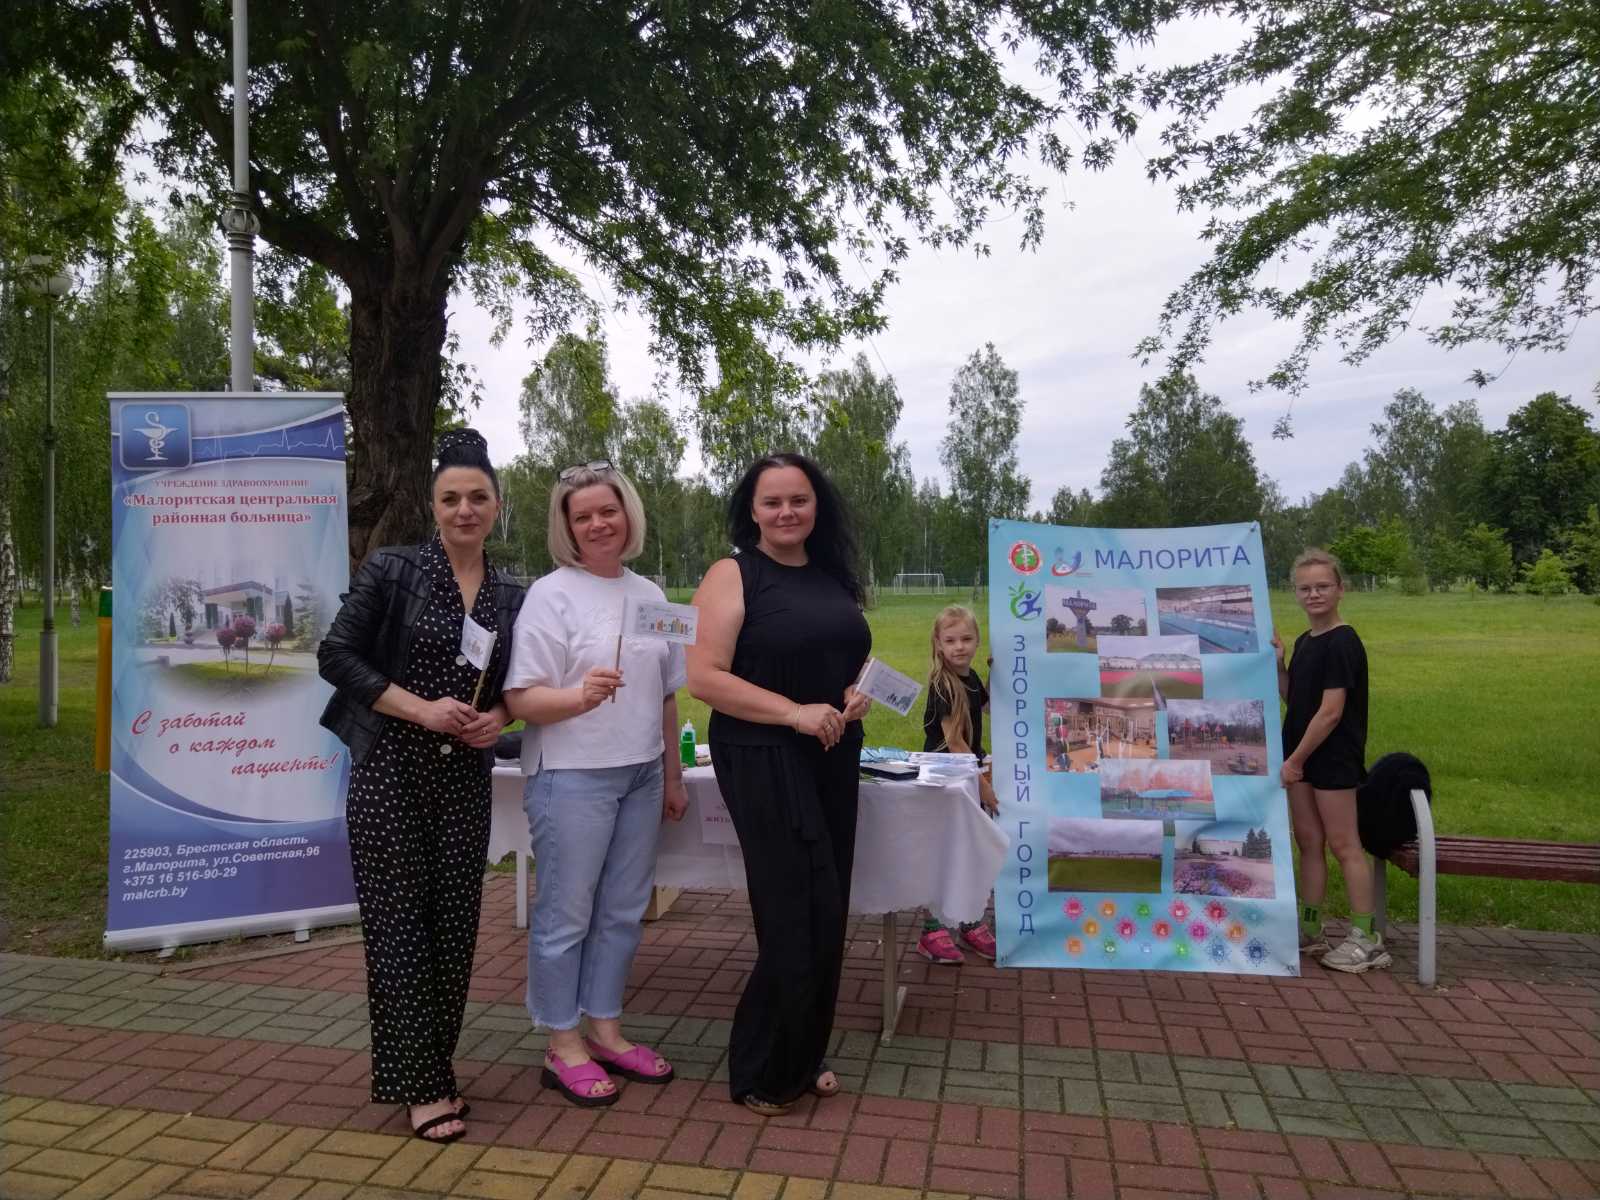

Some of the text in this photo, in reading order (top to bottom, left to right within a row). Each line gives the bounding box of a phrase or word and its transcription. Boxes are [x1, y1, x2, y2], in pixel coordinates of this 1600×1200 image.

[153, 479, 217, 488] УЧРЕЖДЕНИЕ
[123, 493, 338, 509] «Малоритская центральная
[152, 510, 312, 526] районная больница»
[1094, 544, 1252, 571] МАЛОРИТА
[131, 710, 153, 736] С
[168, 736, 277, 757] о каждом
[231, 751, 341, 778] пациенте!
[1011, 634, 1035, 936] ЗДОРОВЫЙ ГОРОД
[123, 835, 310, 860] 225903, Брестская область
[122, 856, 210, 874] г.Малорита,
[123, 866, 238, 888] +375 16 516-90-29
[122, 885, 189, 902] malcrb.by
